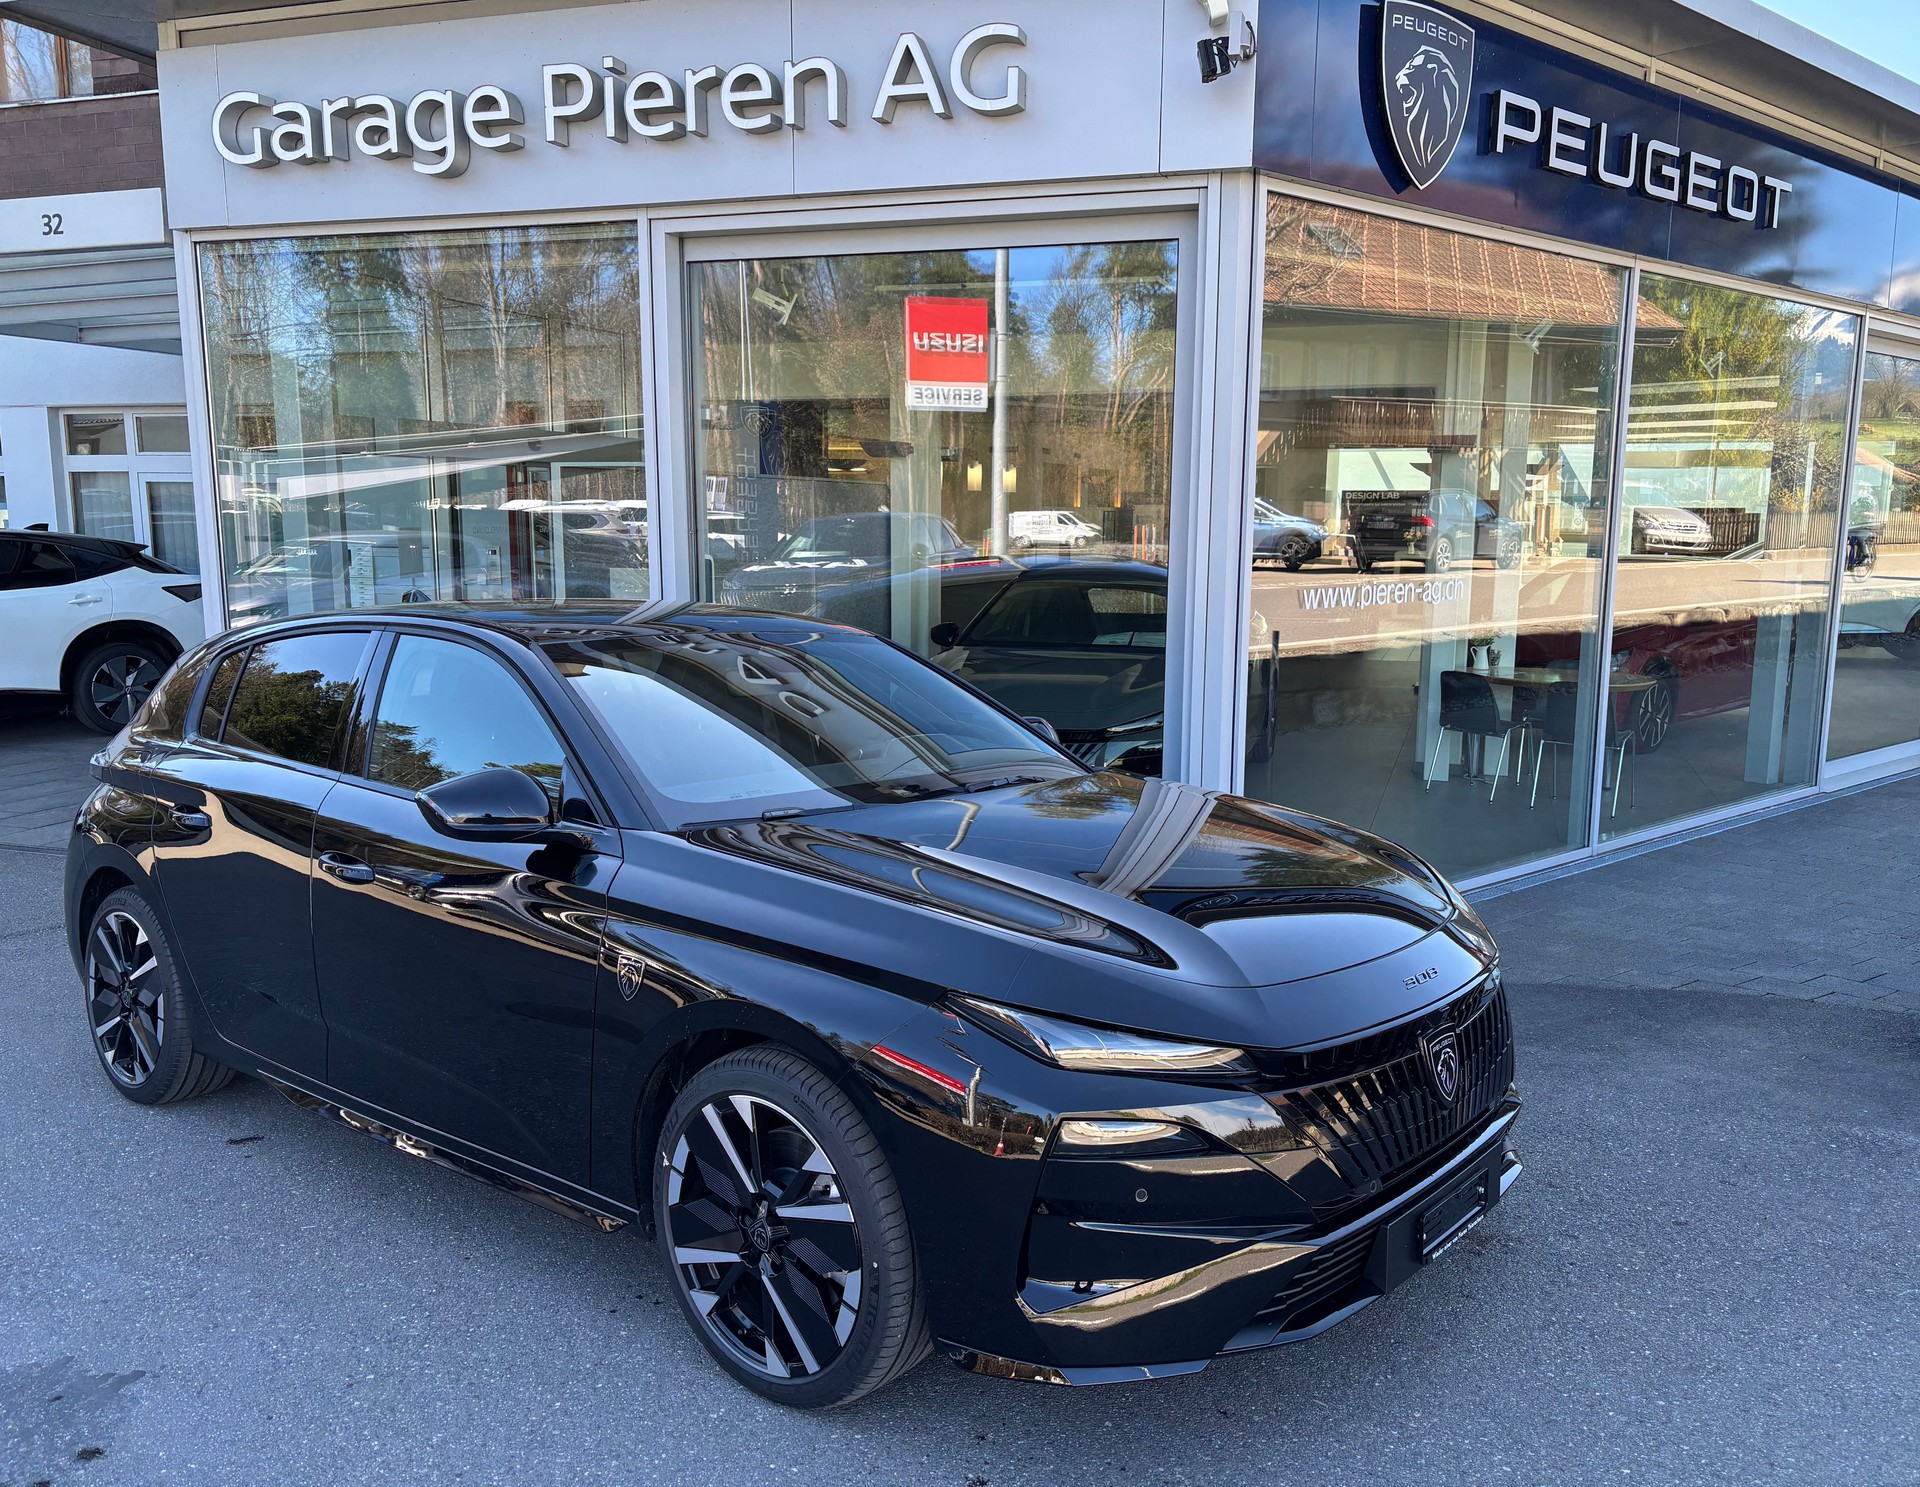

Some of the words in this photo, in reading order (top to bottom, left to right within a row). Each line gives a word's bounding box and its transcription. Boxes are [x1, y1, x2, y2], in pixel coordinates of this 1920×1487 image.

[1393, 14, 1468, 50] PEUGEOT
[211, 84, 525, 179] Garage
[542, 56, 848, 147] Pieren
[871, 21, 1028, 124] AG
[1495, 88, 1794, 230] PEUGEOT
[41, 213, 64, 236] 32
[1345, 491, 1380, 500] DESIGN
[1381, 491, 1400, 500] LAB
[1303, 577, 1464, 610] www.pieren-ag.ch
[1402, 966, 1439, 991] 308
[1432, 1037, 1454, 1053] PEUGEOT
